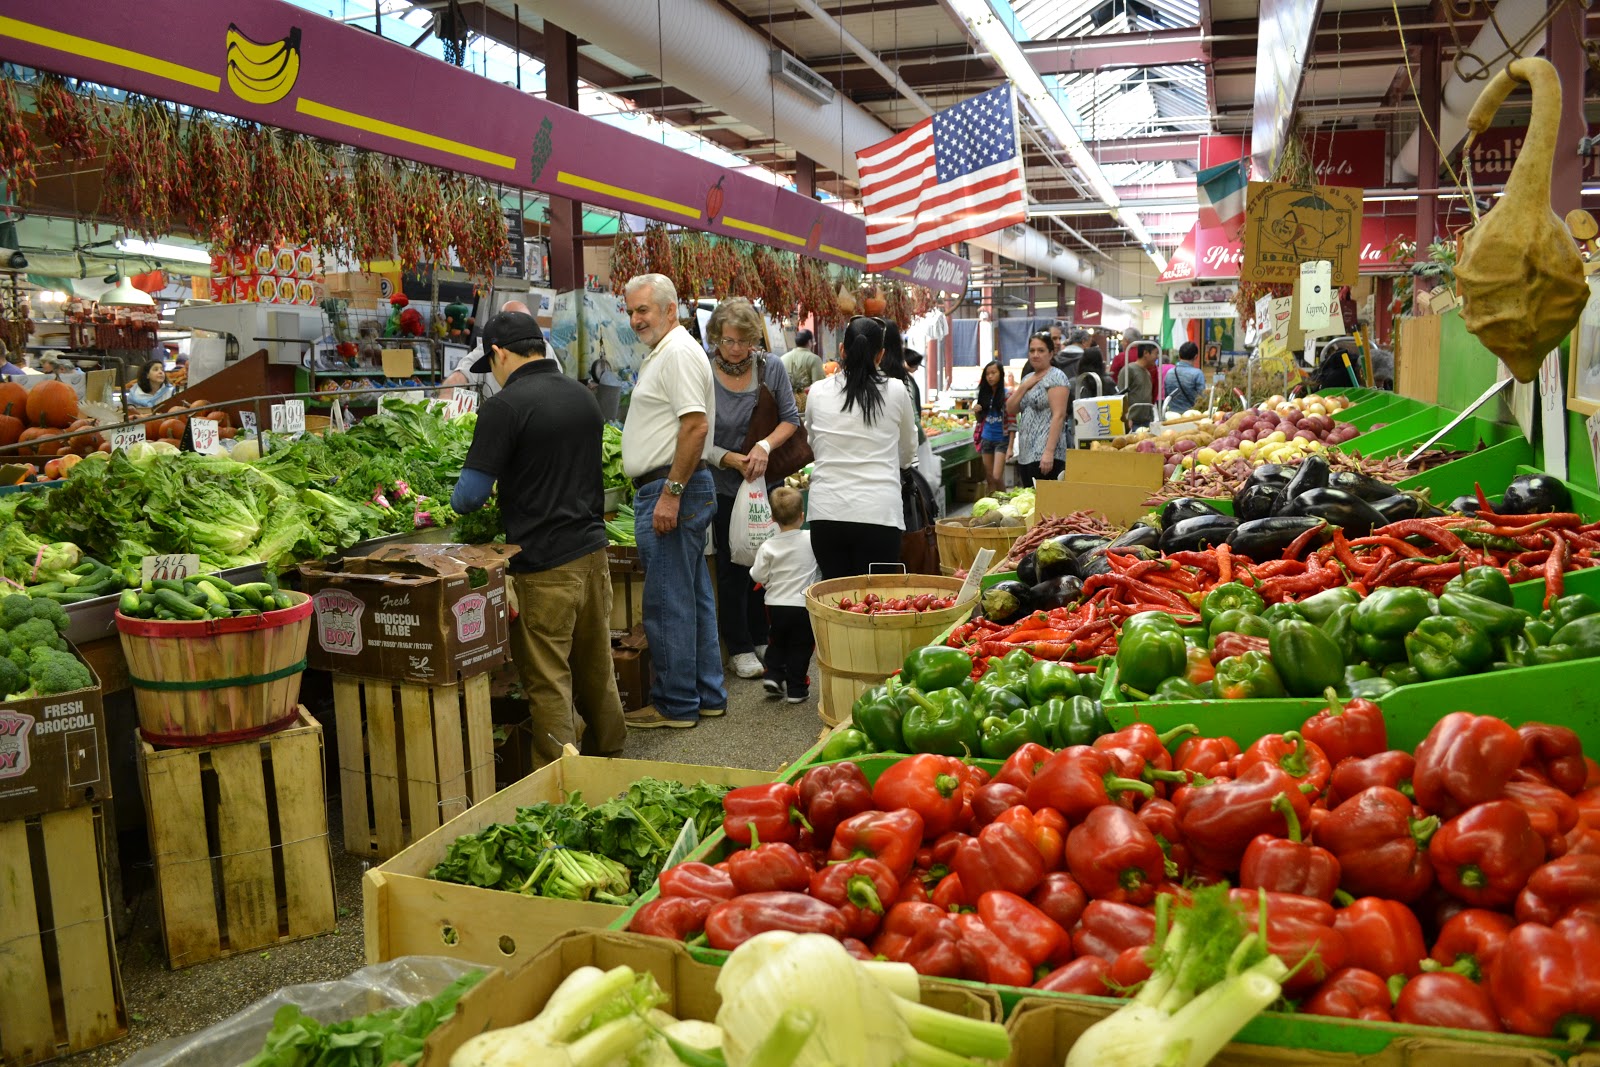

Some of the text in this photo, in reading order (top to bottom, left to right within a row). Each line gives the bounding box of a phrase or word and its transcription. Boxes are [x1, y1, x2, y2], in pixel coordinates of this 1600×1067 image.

[1459, 138, 1523, 173] tali
[933, 258, 955, 283] FOOD
[1275, 298, 1291, 311] SA
[116, 426, 136, 435] SALE
[154, 555, 187, 568] SALE
[319, 596, 358, 616] ANDY
[380, 592, 410, 610] Fresh
[457, 599, 484, 616] ANDY
[374, 612, 420, 627] BROCCOLI
[325, 627, 356, 647] BOY
[384, 624, 411, 637] RABE
[462, 621, 481, 636] BOY
[44, 700, 84, 719] FRESH
[35, 713, 95, 735] BROCCOLI
